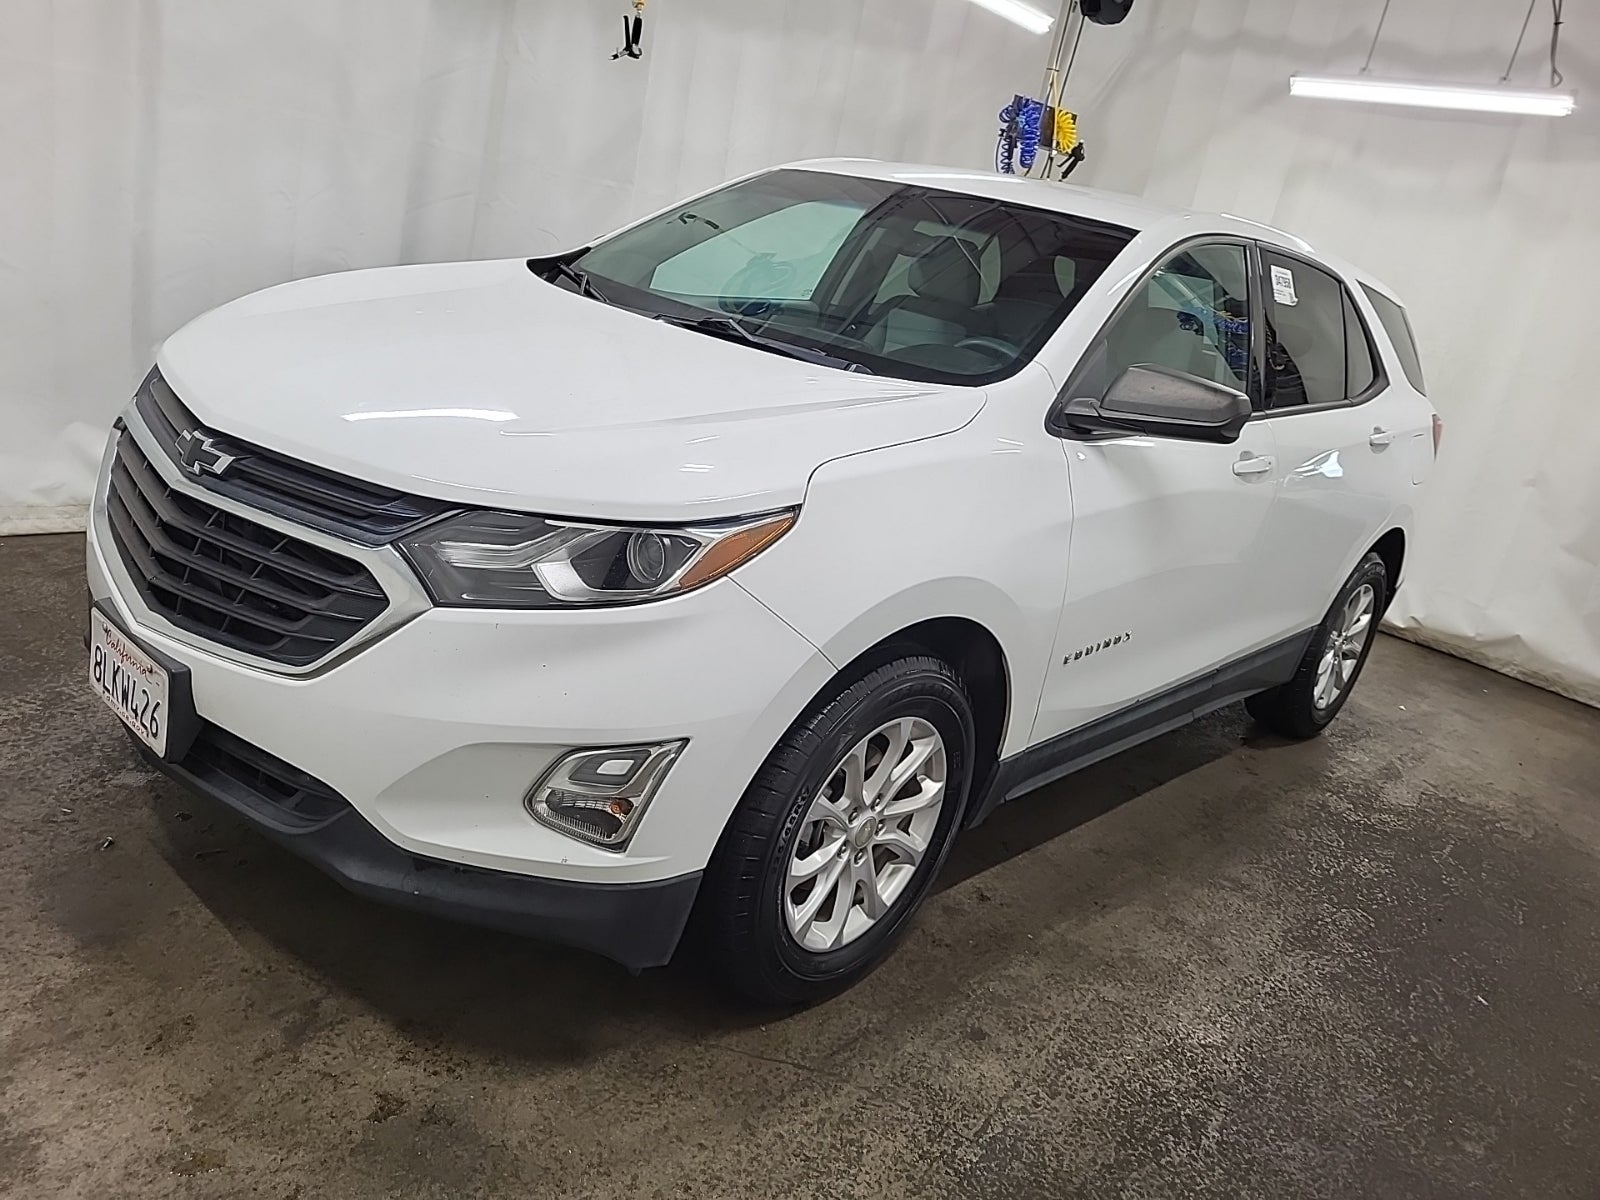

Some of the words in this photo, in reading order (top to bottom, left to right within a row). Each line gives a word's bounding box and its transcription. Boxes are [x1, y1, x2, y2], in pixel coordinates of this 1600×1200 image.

[104, 629, 152, 684] California
[1063, 630, 1132, 665] EQUINOX
[93, 644, 161, 739] 8LKW426
